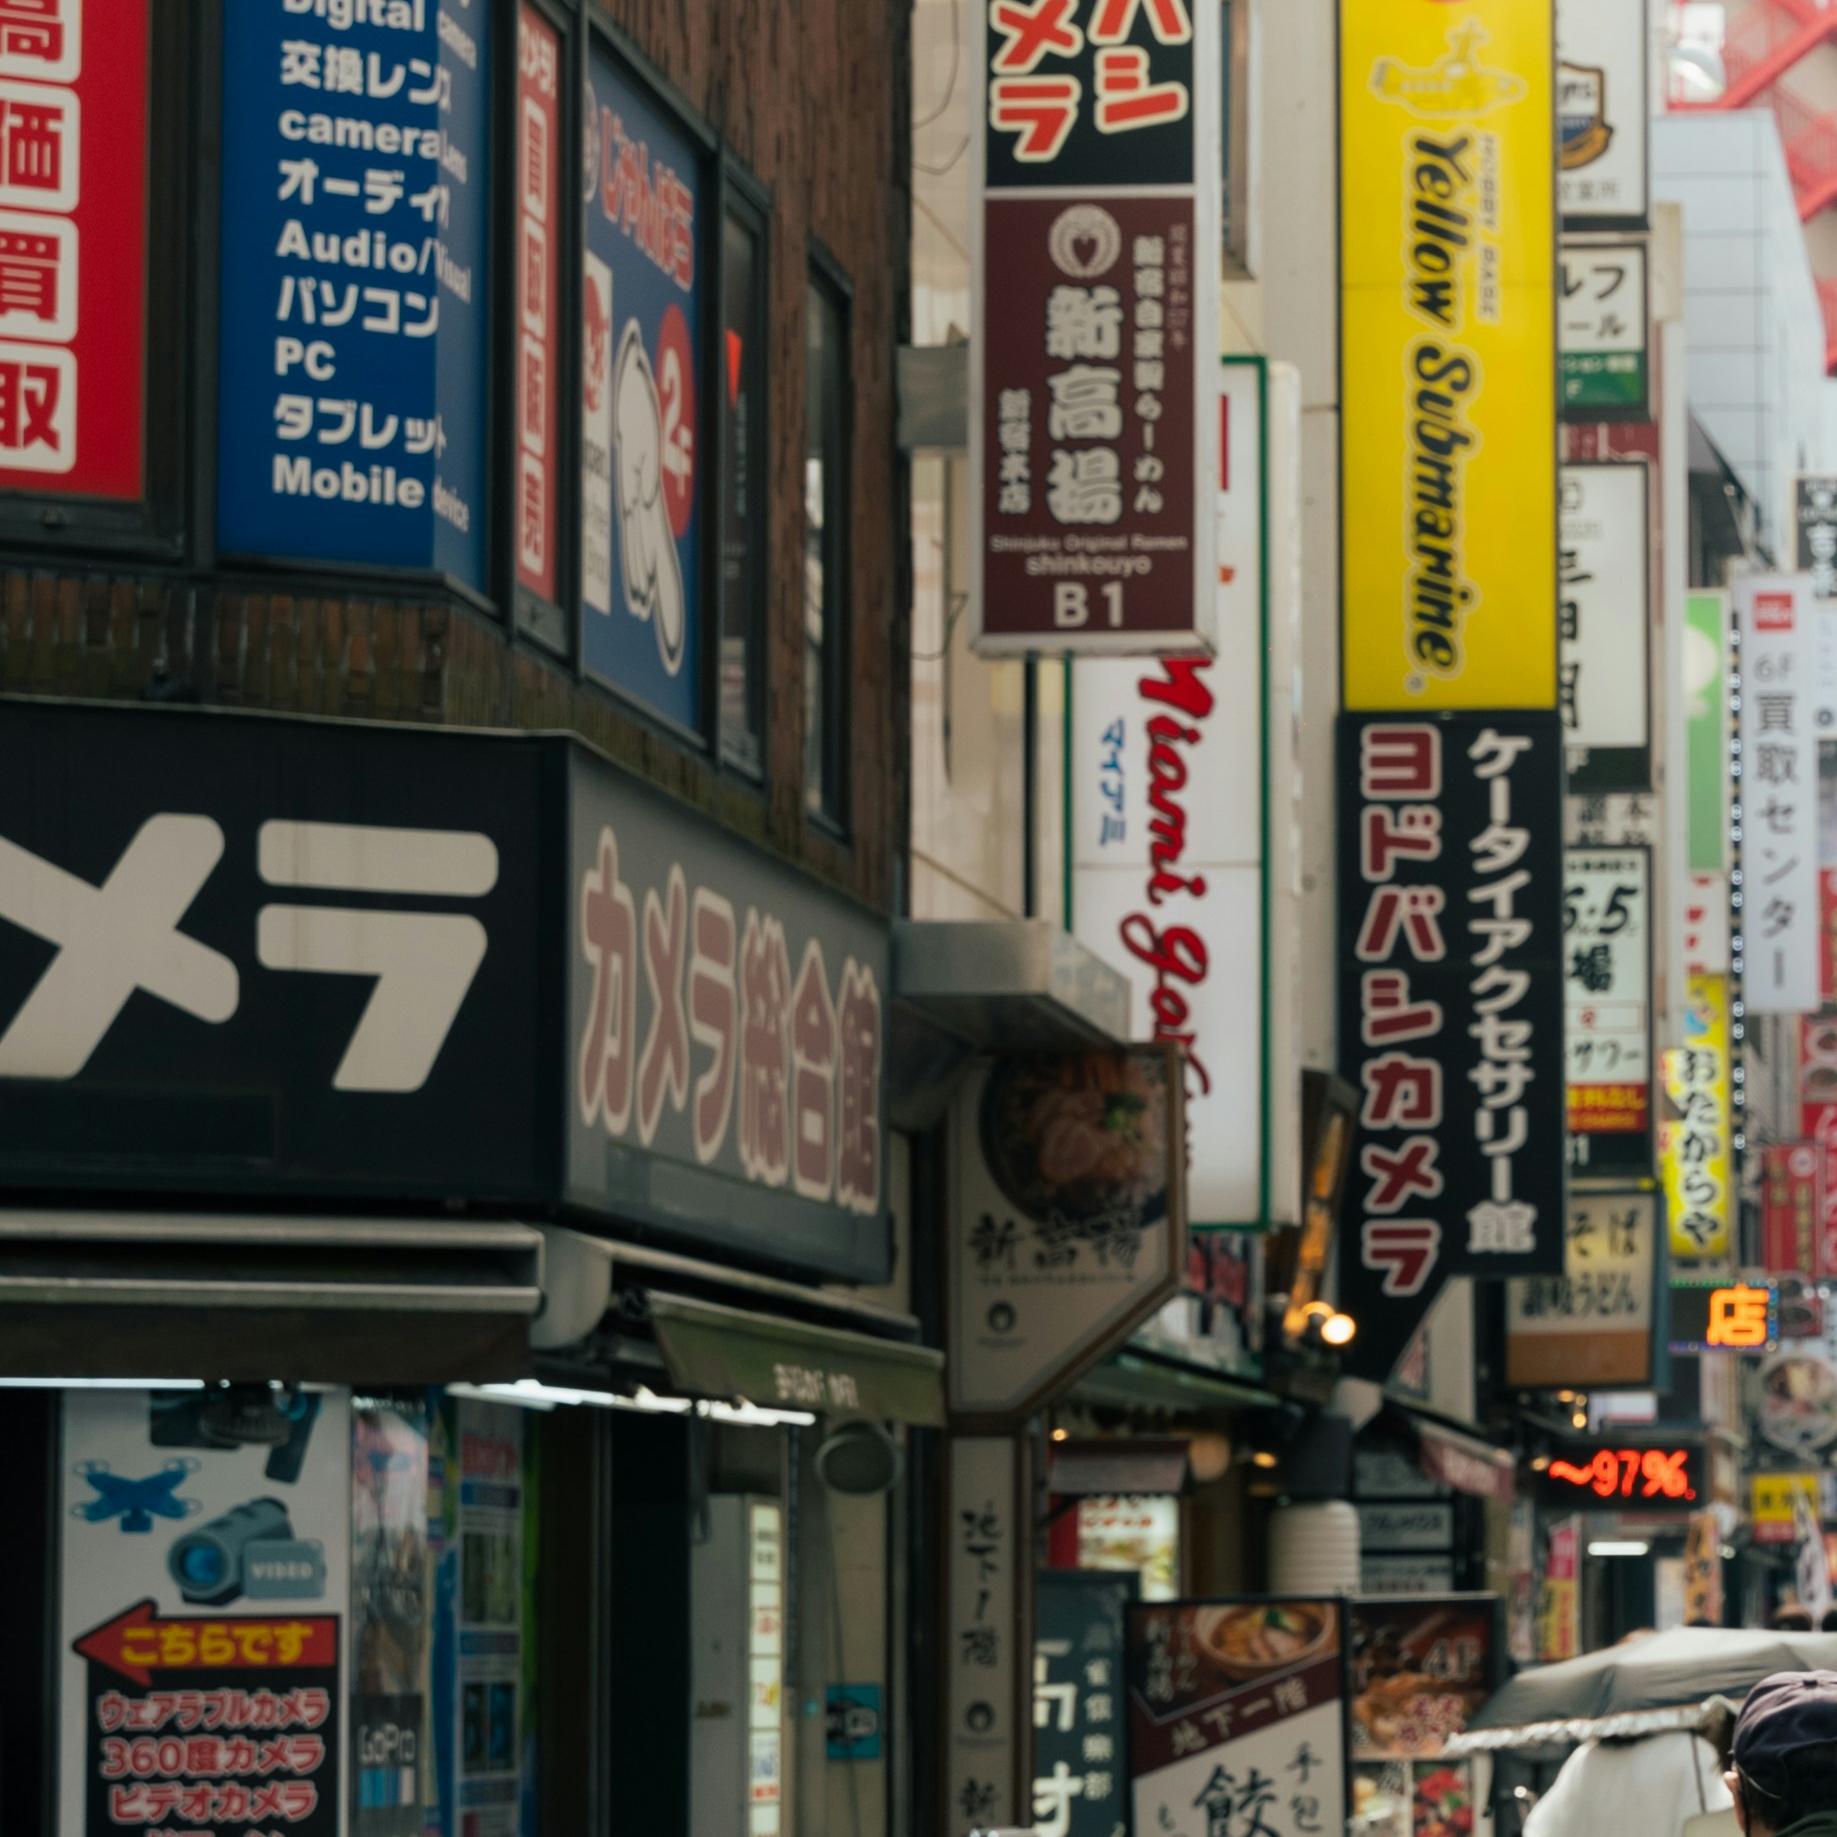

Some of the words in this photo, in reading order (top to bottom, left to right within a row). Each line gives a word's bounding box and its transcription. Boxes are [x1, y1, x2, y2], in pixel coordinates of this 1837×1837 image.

[1412, 137, 1472, 326] Yellow
[276, 275, 439, 329] パソコン
[275, 336, 336, 381] PC
[274, 393, 447, 461] タブレット
[272, 453, 425, 509] Mobile
[1413, 341, 1474, 669] Submarine
[1053, 581, 1124, 628] B1
[1754, 689, 1798, 991] 買取センター
[0, 813, 500, 1093] メラ
[577, 825, 883, 1217] カメラ総合館
[1356, 723, 1446, 1297] ヨドバシカメラ
[1466, 727, 1538, 1255] ケータイアクセサリー館
[1682, 1046, 1720, 1246] おたからや
[1706, 1284, 1769, 1347] 店
[249, 1558, 313, 1582] VIDEO
[120, 1624, 313, 1666] こちらです
[98, 1687, 330, 1731] ウェアラブルカメラ
[101, 1734, 325, 1778] 360度カメラ
[110, 1782, 319, 1824] ビデオカメラ
